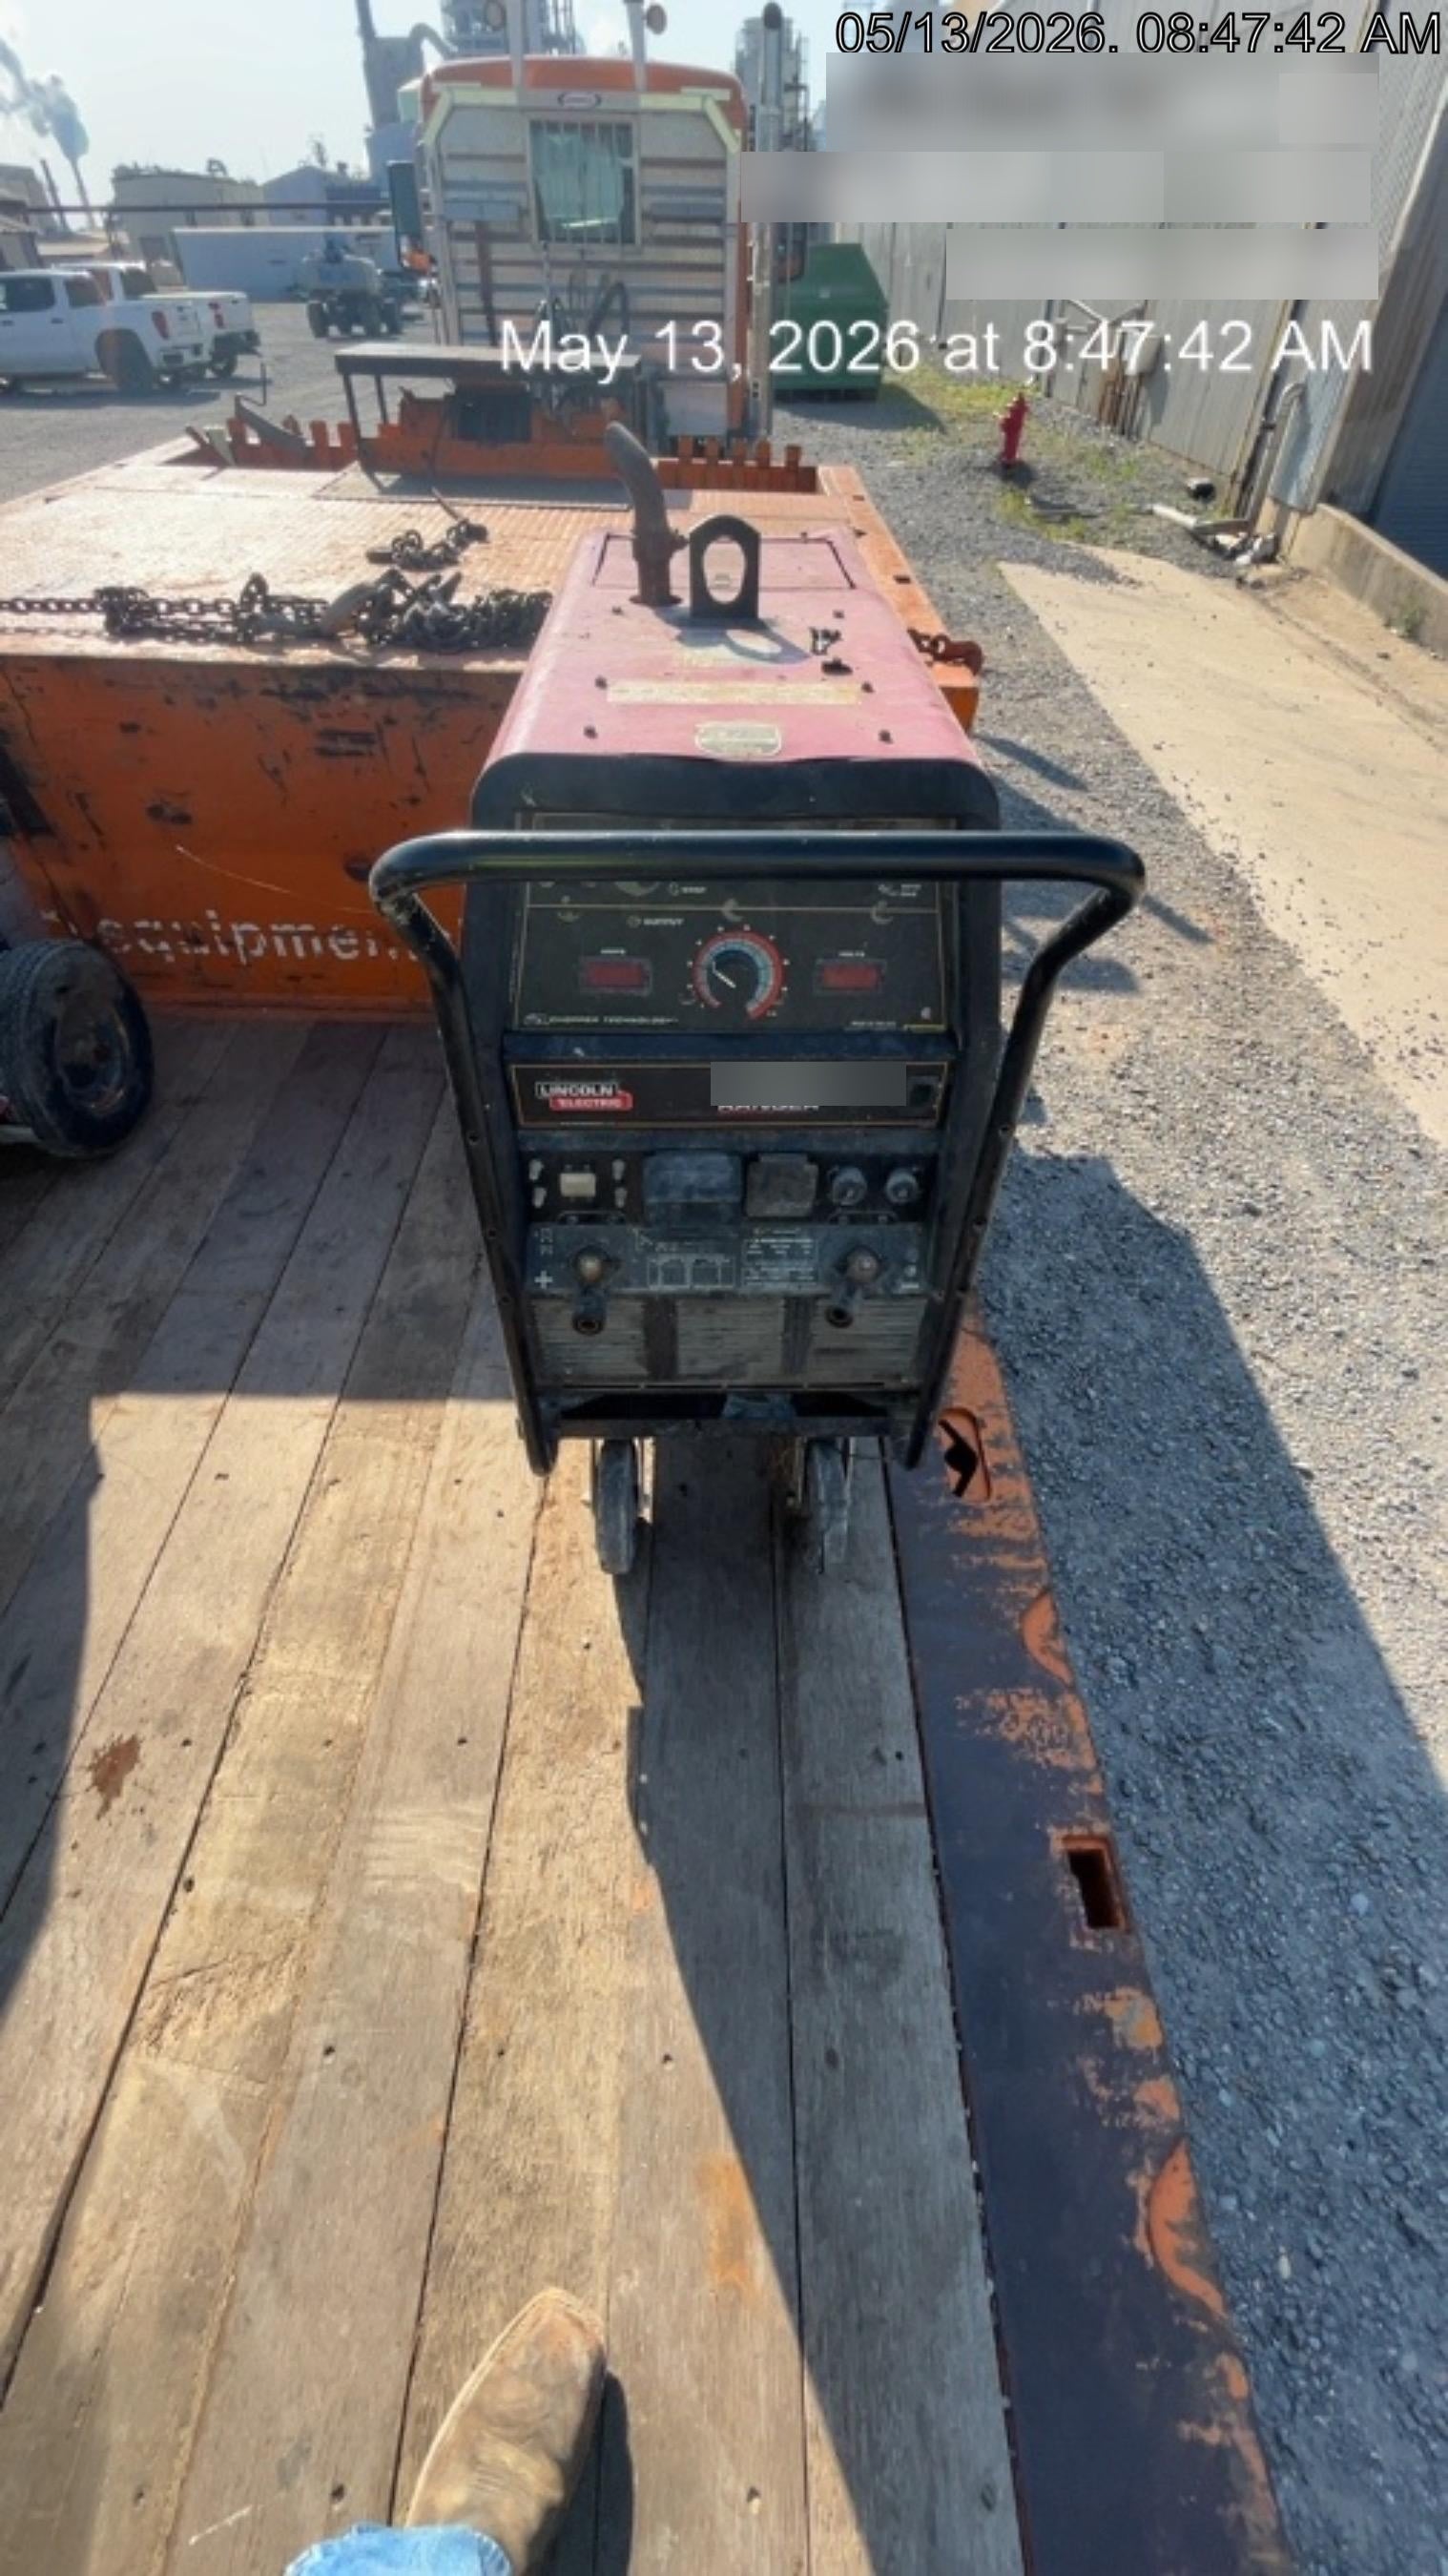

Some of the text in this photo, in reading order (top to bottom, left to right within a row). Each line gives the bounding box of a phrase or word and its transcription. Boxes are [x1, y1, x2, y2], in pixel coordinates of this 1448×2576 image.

[96, 909, 420, 965] equipme
[541, 1084, 615, 1097] LINCOLN
[557, 1097, 626, 1110] ELECTRIC
